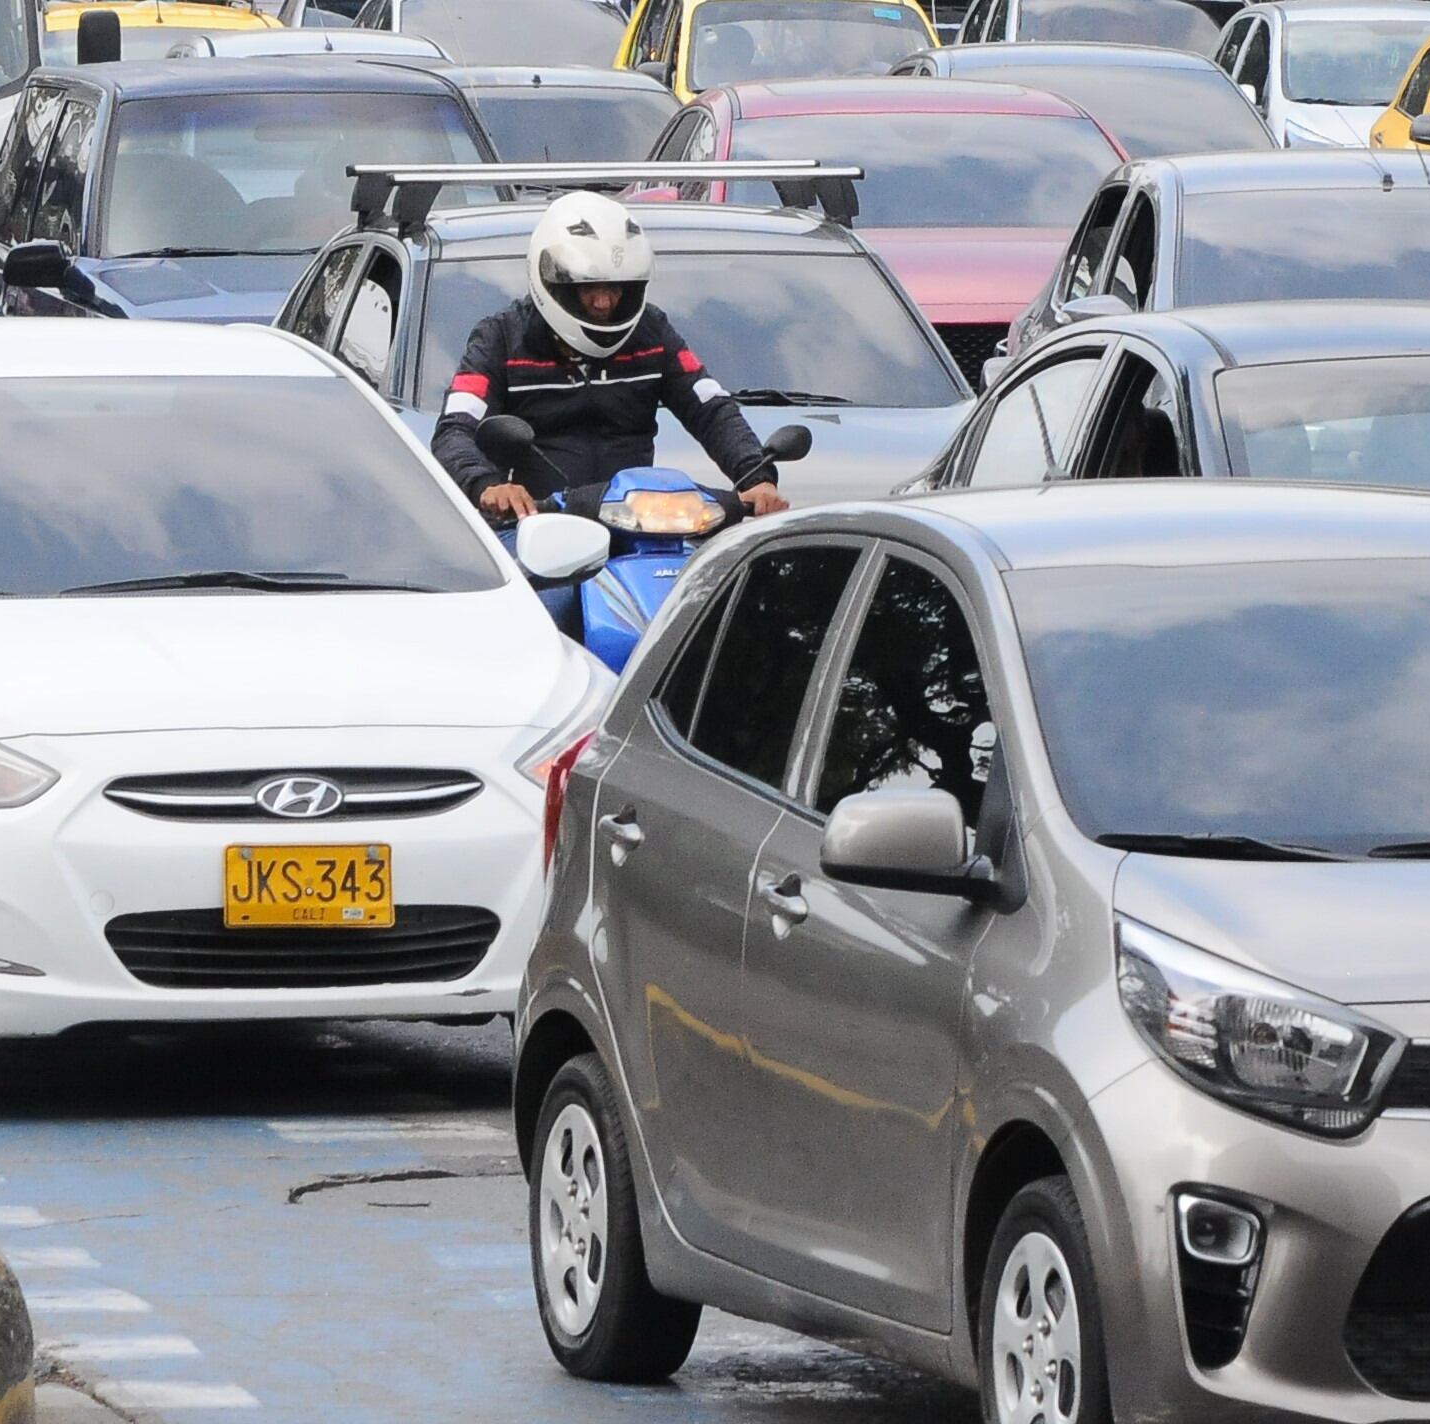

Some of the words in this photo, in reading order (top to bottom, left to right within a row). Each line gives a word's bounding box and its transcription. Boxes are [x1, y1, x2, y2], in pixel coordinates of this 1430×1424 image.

[232, 860, 303, 903] JKS
[315, 859, 386, 903] 343
[292, 907, 326, 920] CALI
